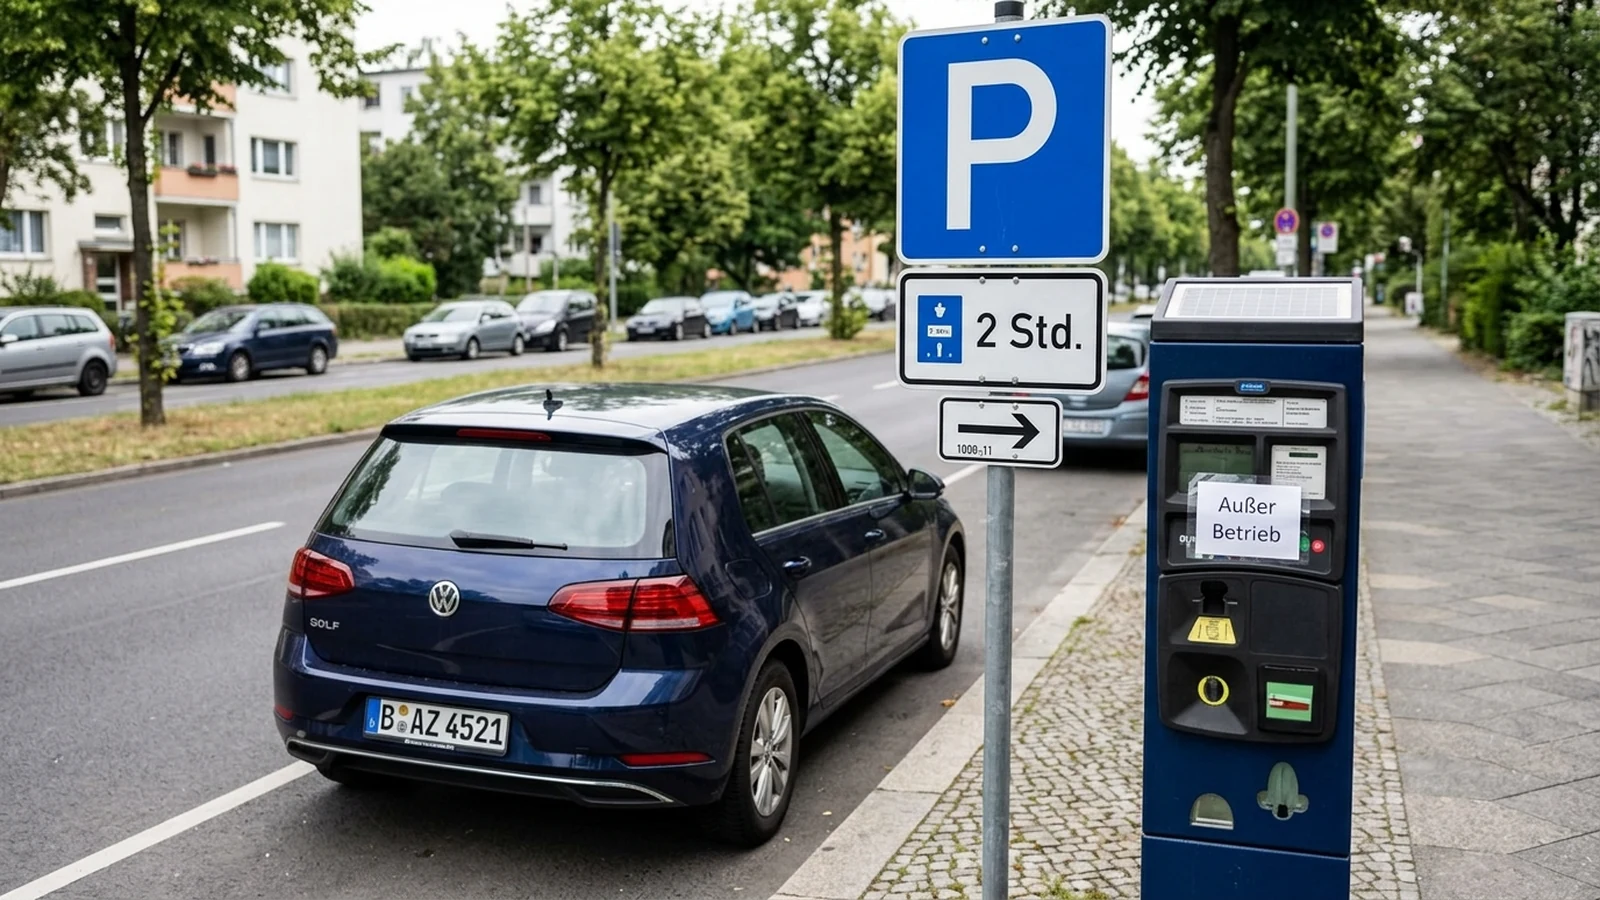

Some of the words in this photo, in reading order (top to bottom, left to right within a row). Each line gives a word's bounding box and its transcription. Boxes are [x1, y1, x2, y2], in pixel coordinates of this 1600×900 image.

[947, 58, 1057, 230] P
[976, 312, 996, 348] 2
[1009, 313, 1082, 350] Std.
[1218, 496, 1277, 515] Außer
[1213, 523, 1281, 543] Betrieb
[380, 704, 395, 731] B
[410, 708, 441, 738] AZ
[445, 712, 503, 746] 4521
